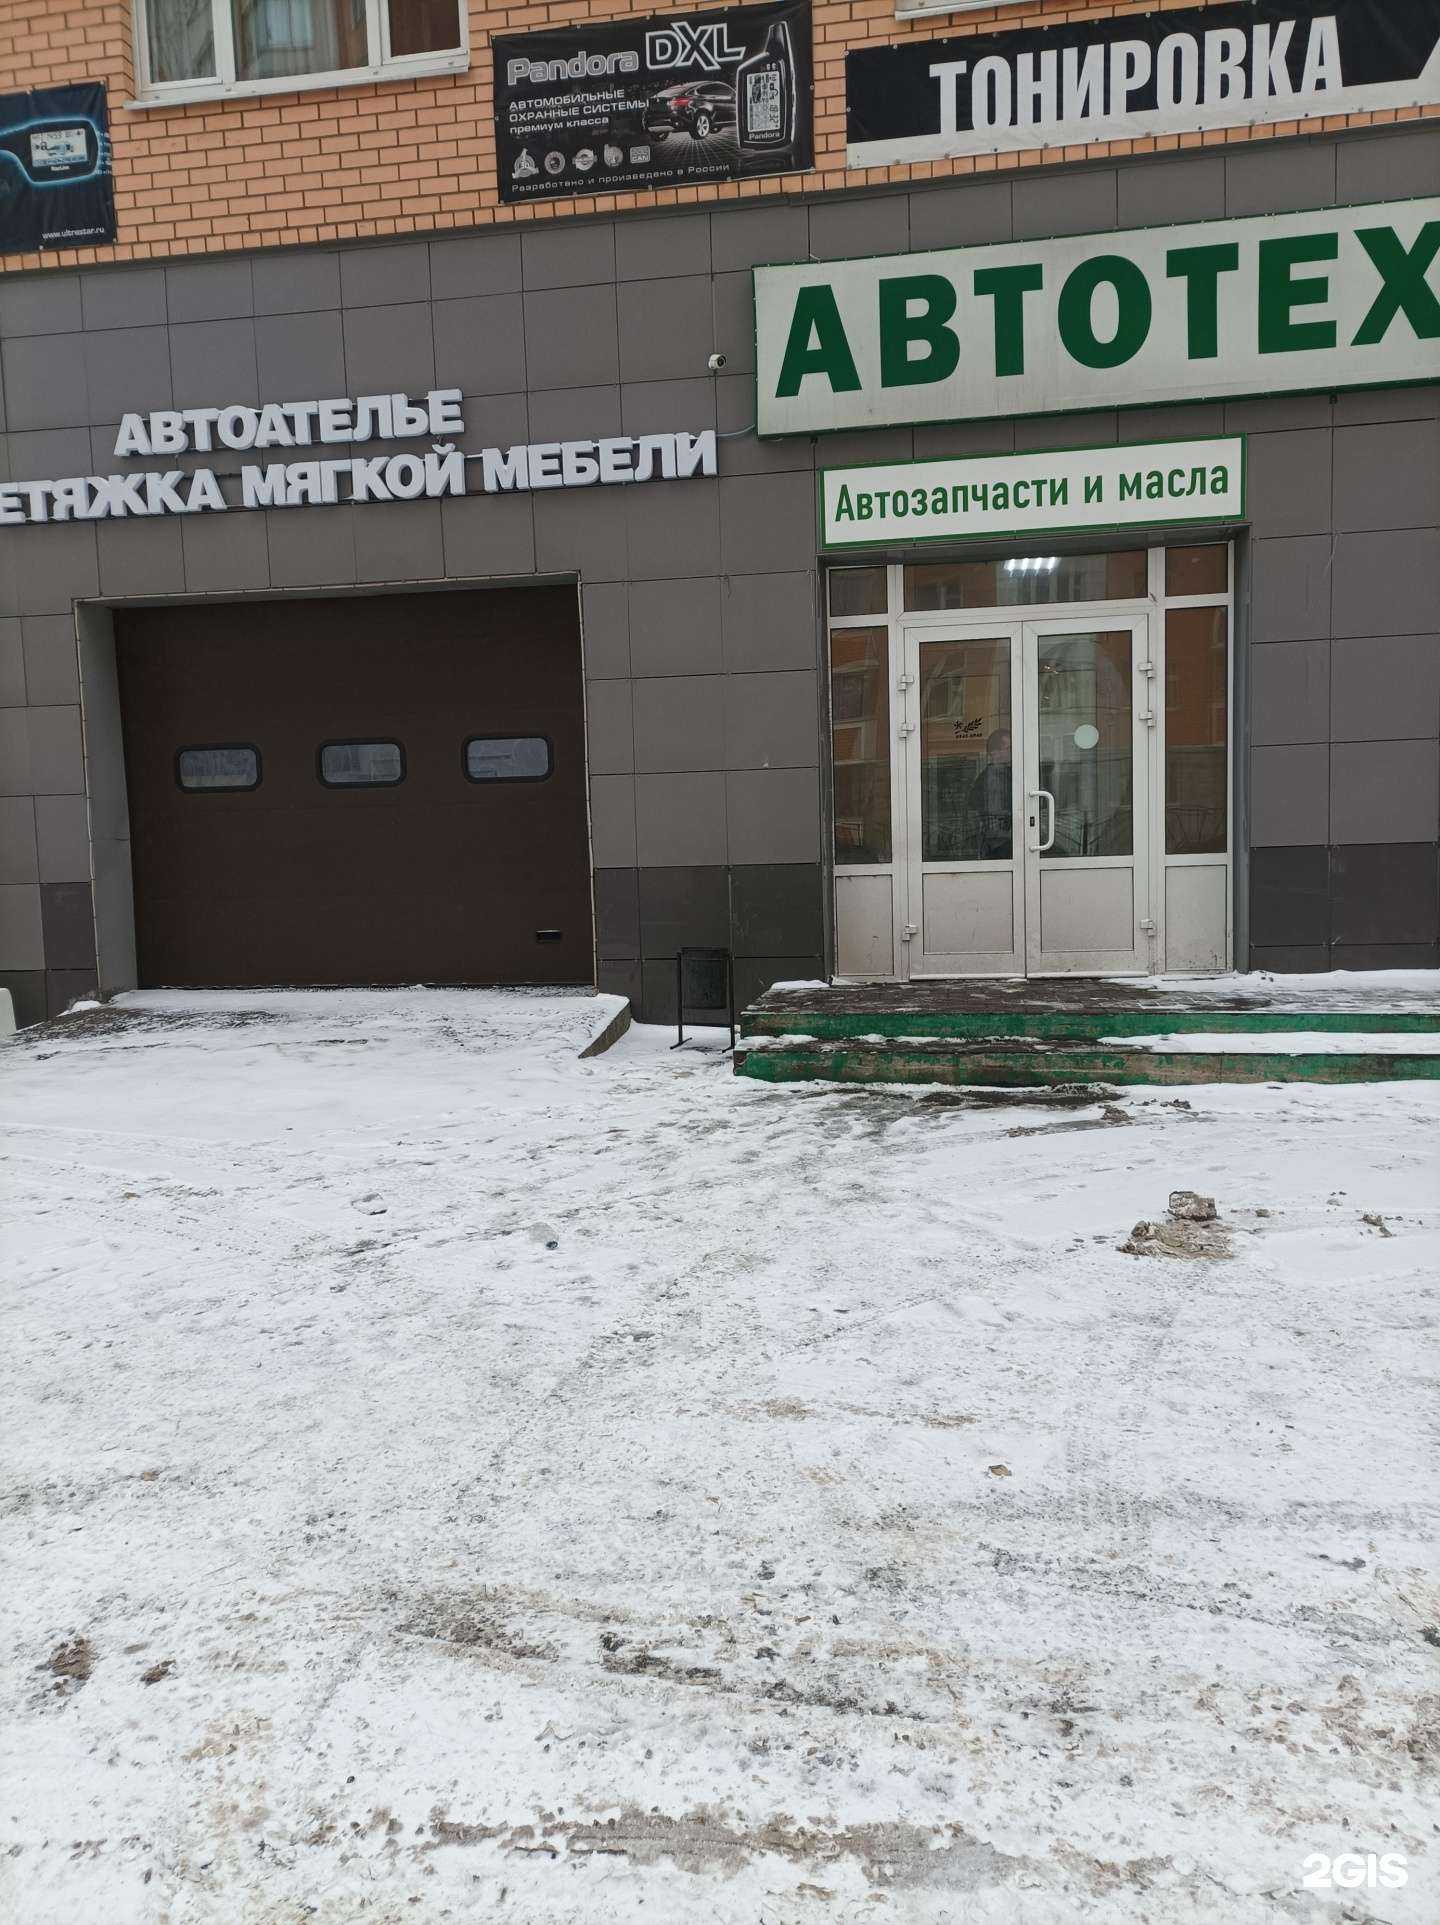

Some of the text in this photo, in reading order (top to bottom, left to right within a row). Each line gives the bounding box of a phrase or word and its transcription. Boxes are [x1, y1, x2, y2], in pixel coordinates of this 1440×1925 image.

[507, 21, 746, 85] Pandora DXL
[929, 15, 1344, 135] ТОНИРОВКА
[509, 89, 625, 111] АВТОМОБИЛЬНЫЕ
[509, 99, 649, 122] ОХРАННЫЕ СИСТЕМЫ
[510, 117, 609, 134] премиум класса
[749, 131, 780, 140] Pandora
[512, 163, 730, 192] Разработано и произведено в России
[775, 221, 1440, 398] АВТОТЕХ
[114, 388, 465, 458] АВТОАТЕЛЬЕ
[241, 443, 465, 506] МЯГКОЙ
[482, 429, 718, 492] МЕБЕЛИ
[834, 463, 1229, 522] Автозапчасти и масла
